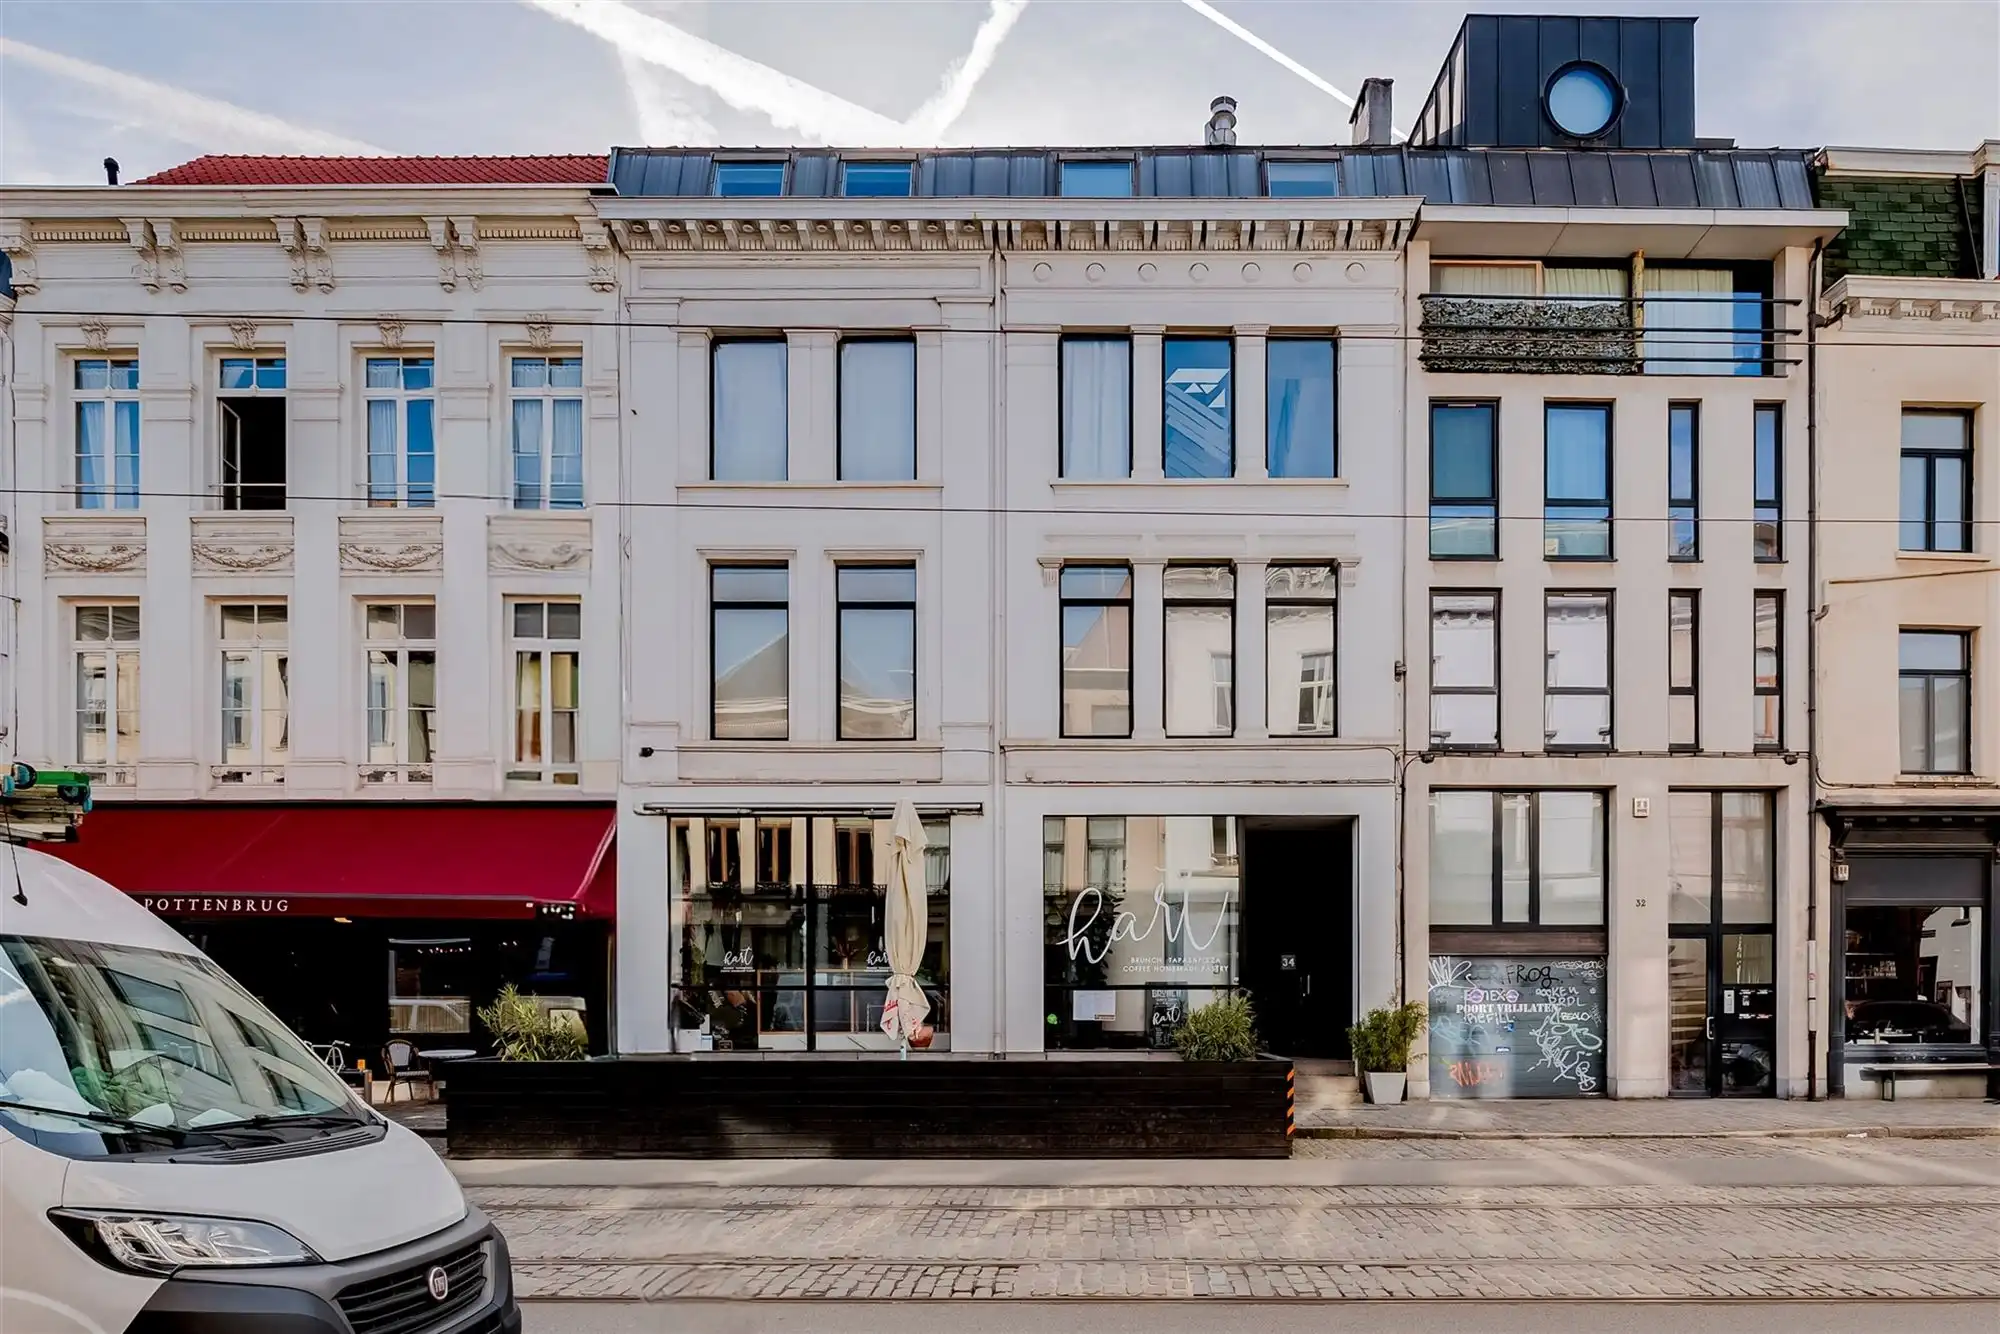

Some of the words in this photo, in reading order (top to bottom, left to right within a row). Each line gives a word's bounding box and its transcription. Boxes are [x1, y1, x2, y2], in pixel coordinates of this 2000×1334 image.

[145, 898, 289, 912] POTTENBRUG
[1635, 899, 1647, 908] 32
[1056, 867, 1229, 965] hart
[723, 946, 754, 966] hart
[1282, 957, 1295, 967] 34
[1152, 1004, 1181, 1025] hart
[1456, 1003, 1495, 1014] POORT
[1497, 1002, 1558, 1013] VRIJLATEN
